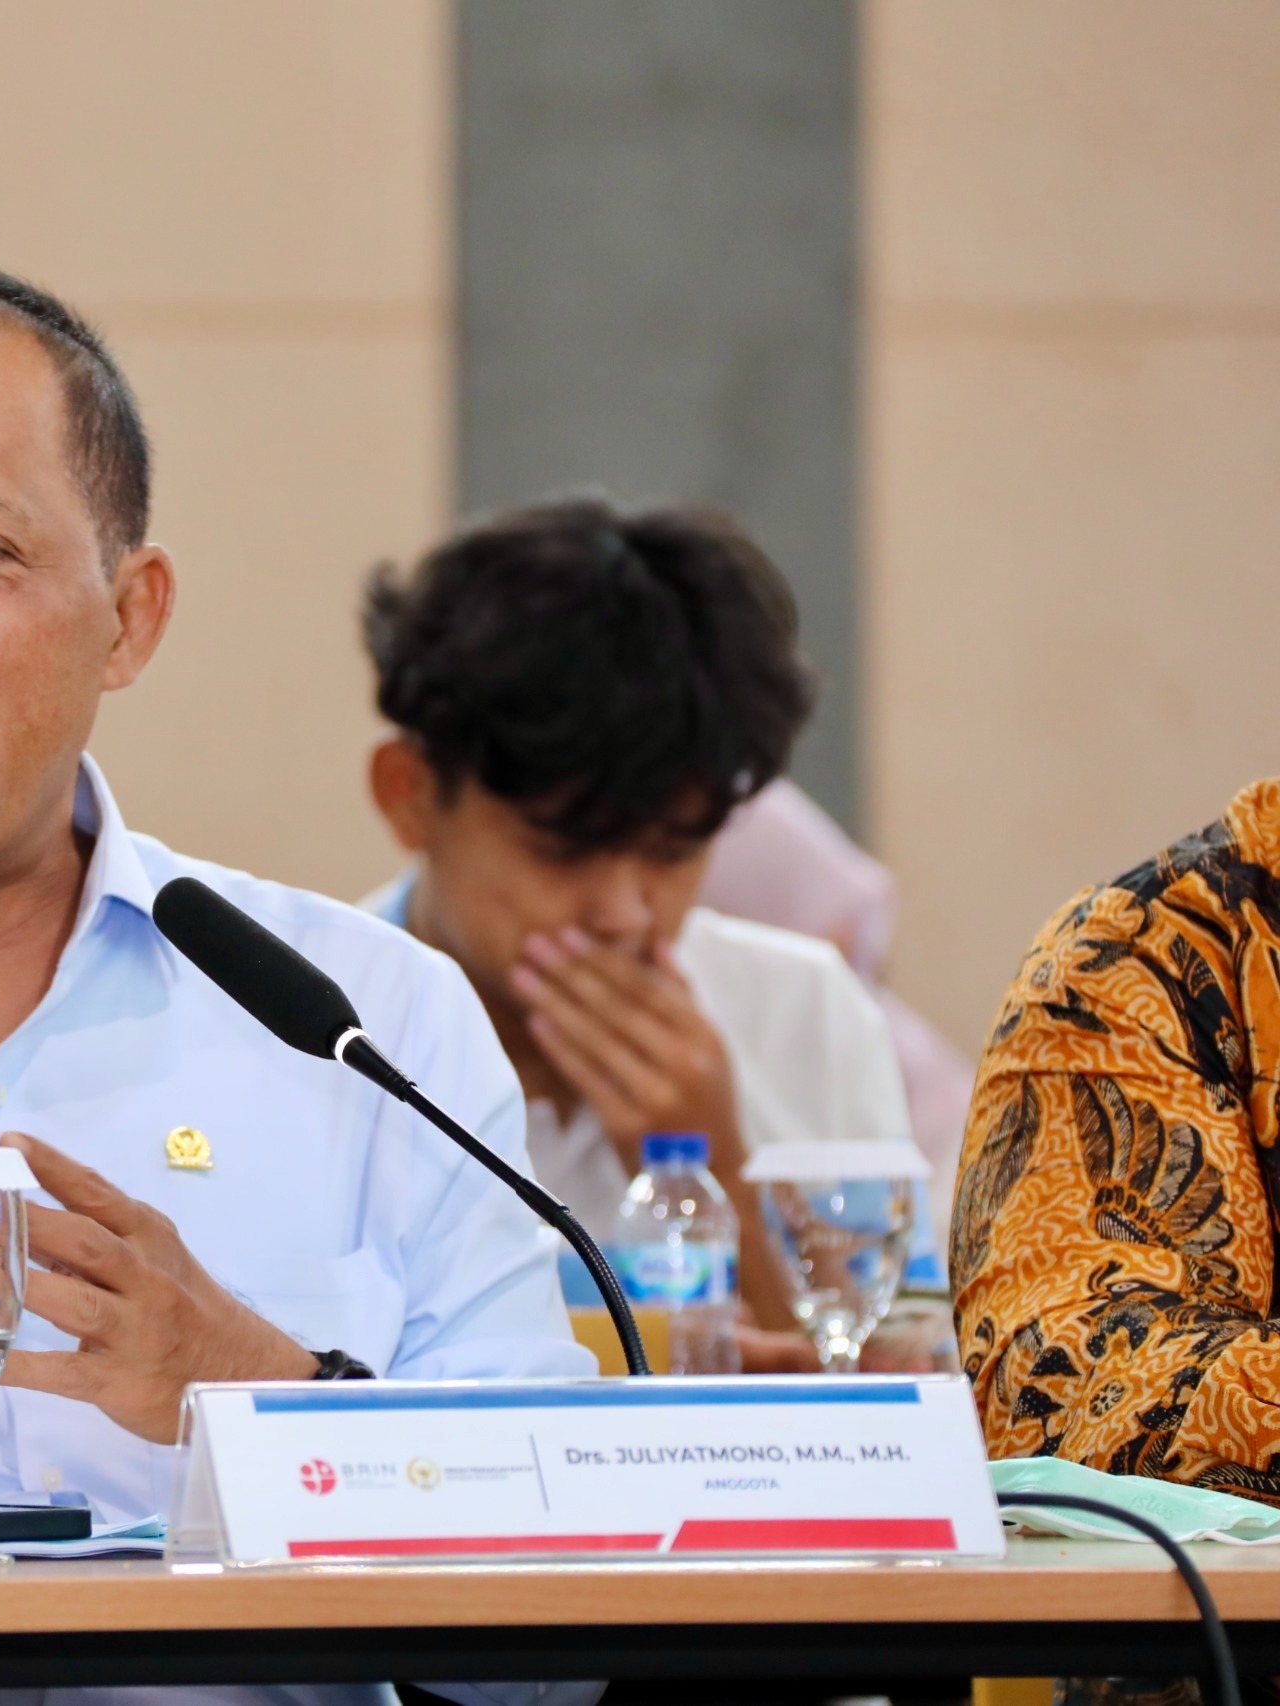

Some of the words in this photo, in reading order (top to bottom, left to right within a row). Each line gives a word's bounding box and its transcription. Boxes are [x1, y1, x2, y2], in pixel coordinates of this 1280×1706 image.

[565, 1447, 611, 1465] Drs.
[616, 1445, 791, 1465] JULIYATMONO,
[796, 1445, 855, 1464] M.M.,
[860, 1444, 911, 1462] M.H.
[705, 1477, 780, 1491] ANGGOTA
